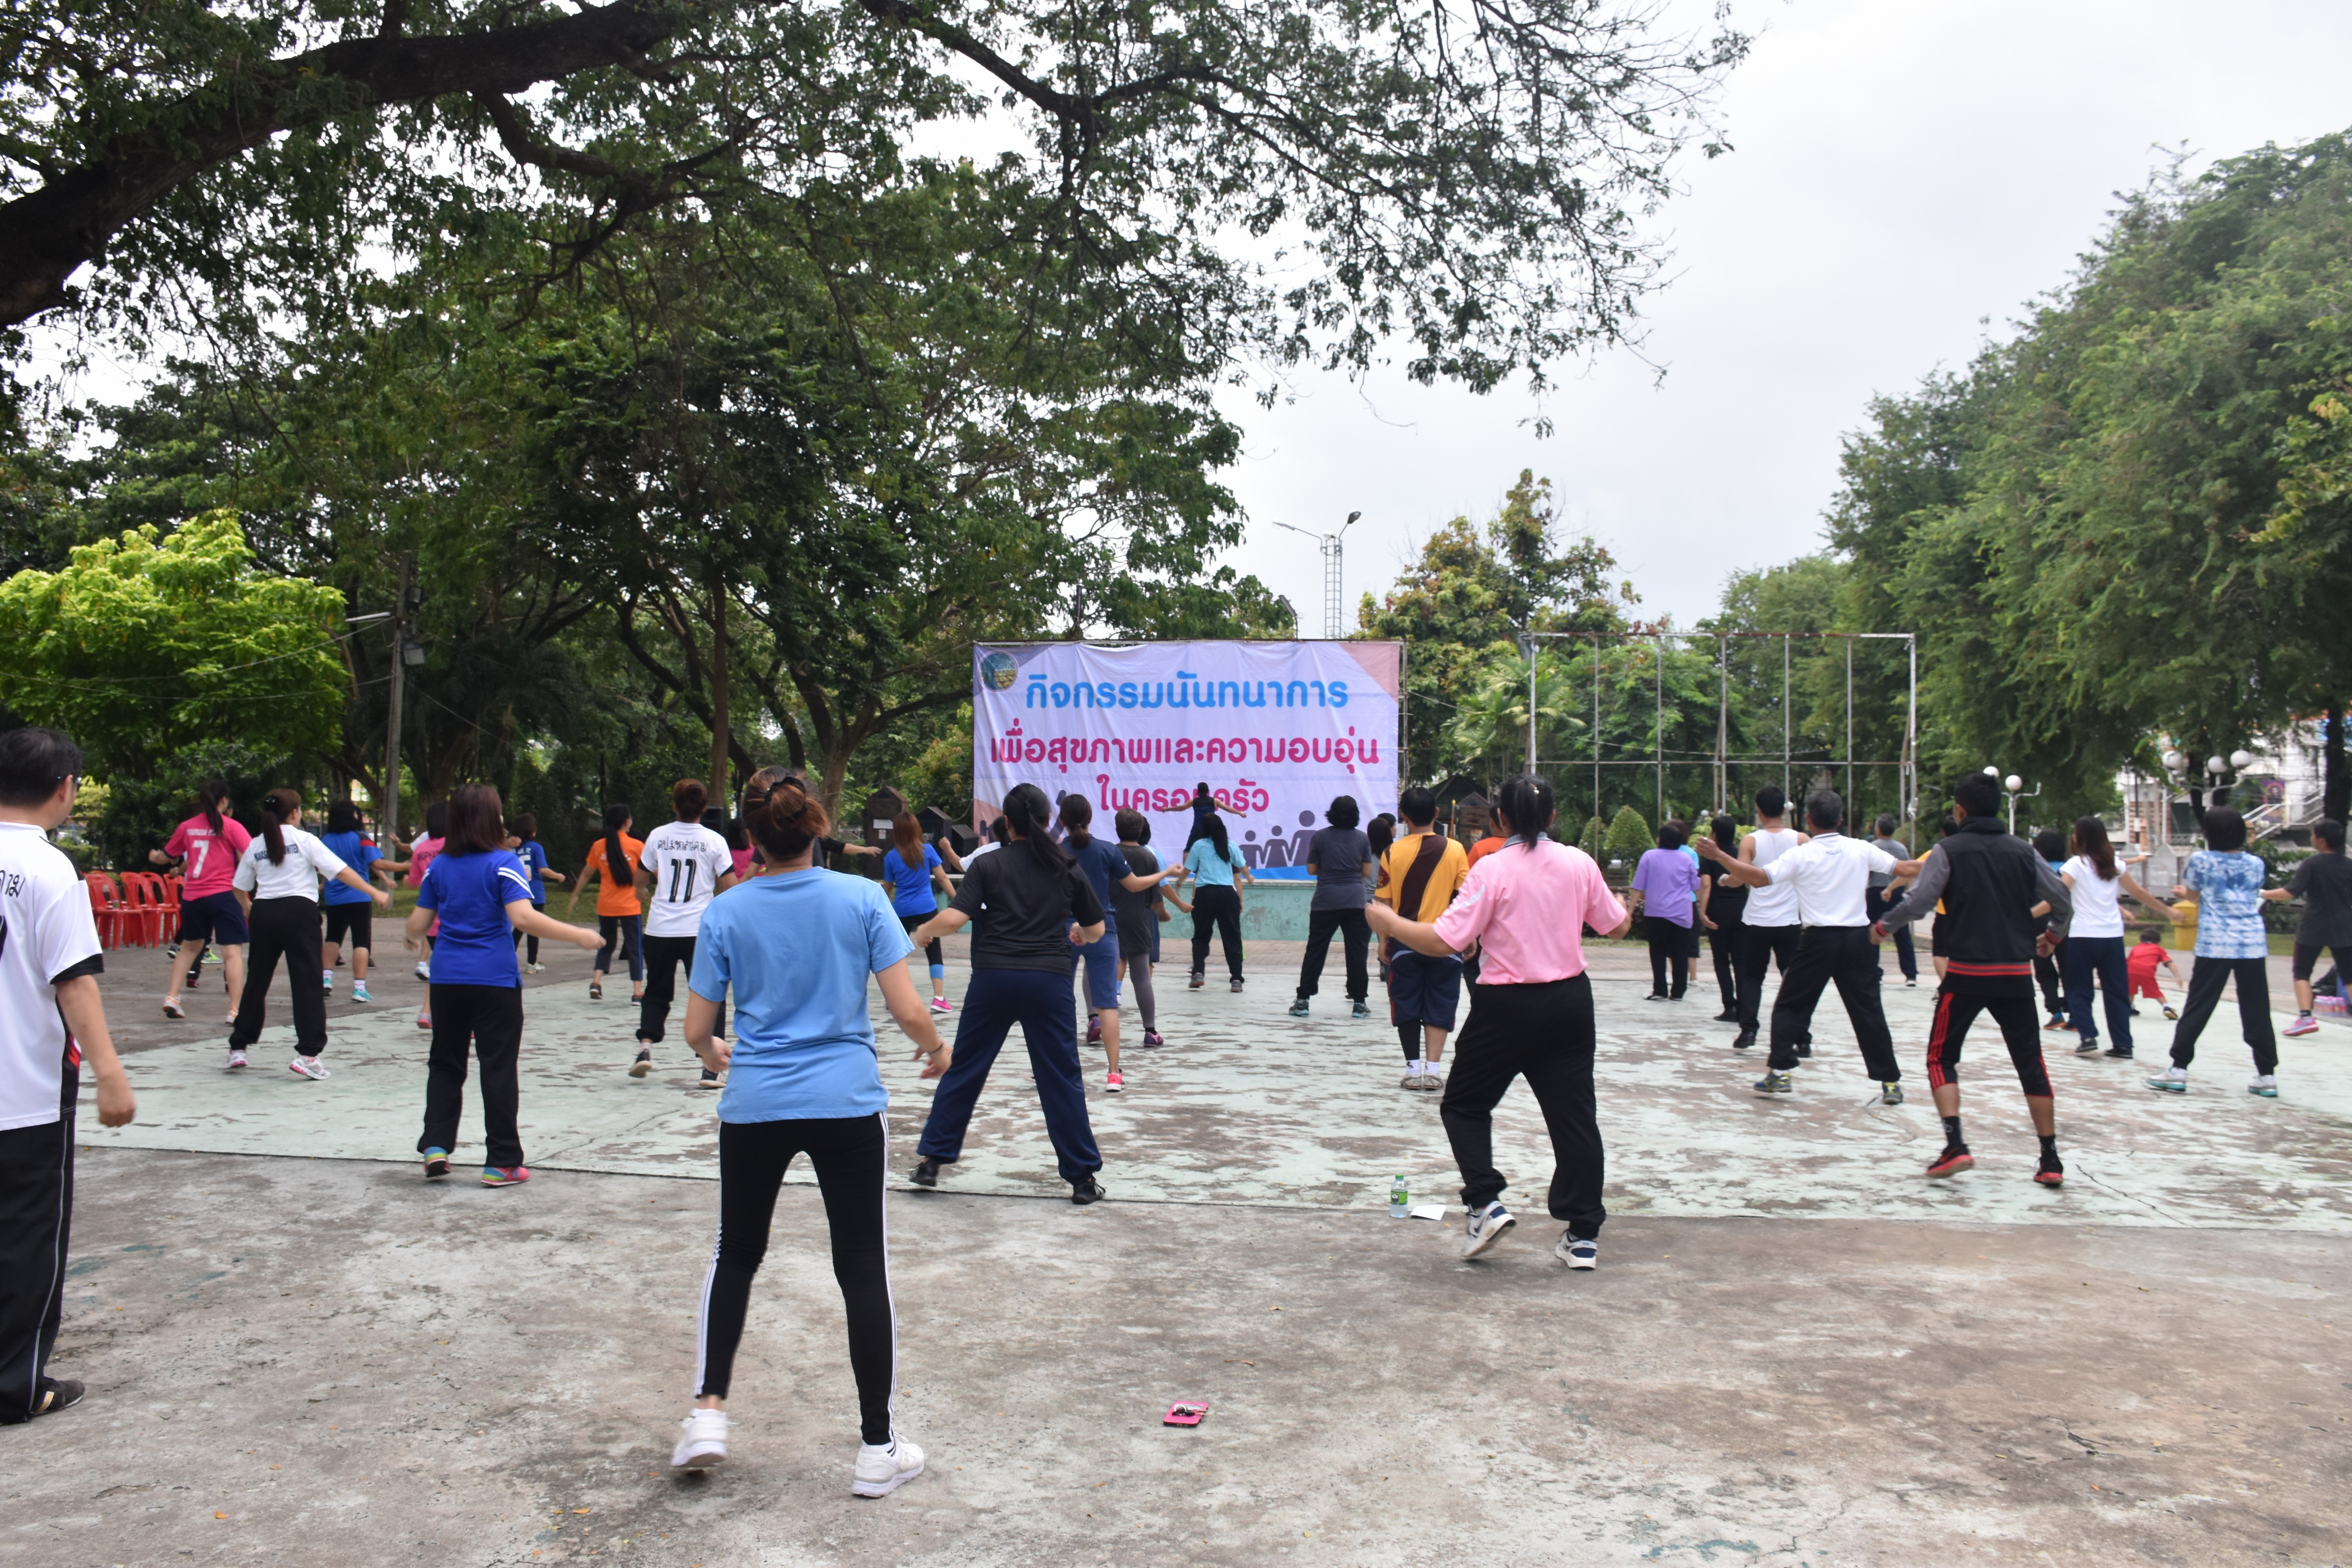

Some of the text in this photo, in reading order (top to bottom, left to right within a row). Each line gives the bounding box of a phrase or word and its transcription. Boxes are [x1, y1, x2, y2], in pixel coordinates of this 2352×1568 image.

[1026, 670, 1348, 709] กิจกรรมนันทนาการ
[991, 718, 1379, 774] เพื่อสุขภาพและความอบอุ่น
[1096, 773, 1270, 811] ในครอครัว
[192, 840, 209, 878] 7
[669, 858, 697, 903] 11
